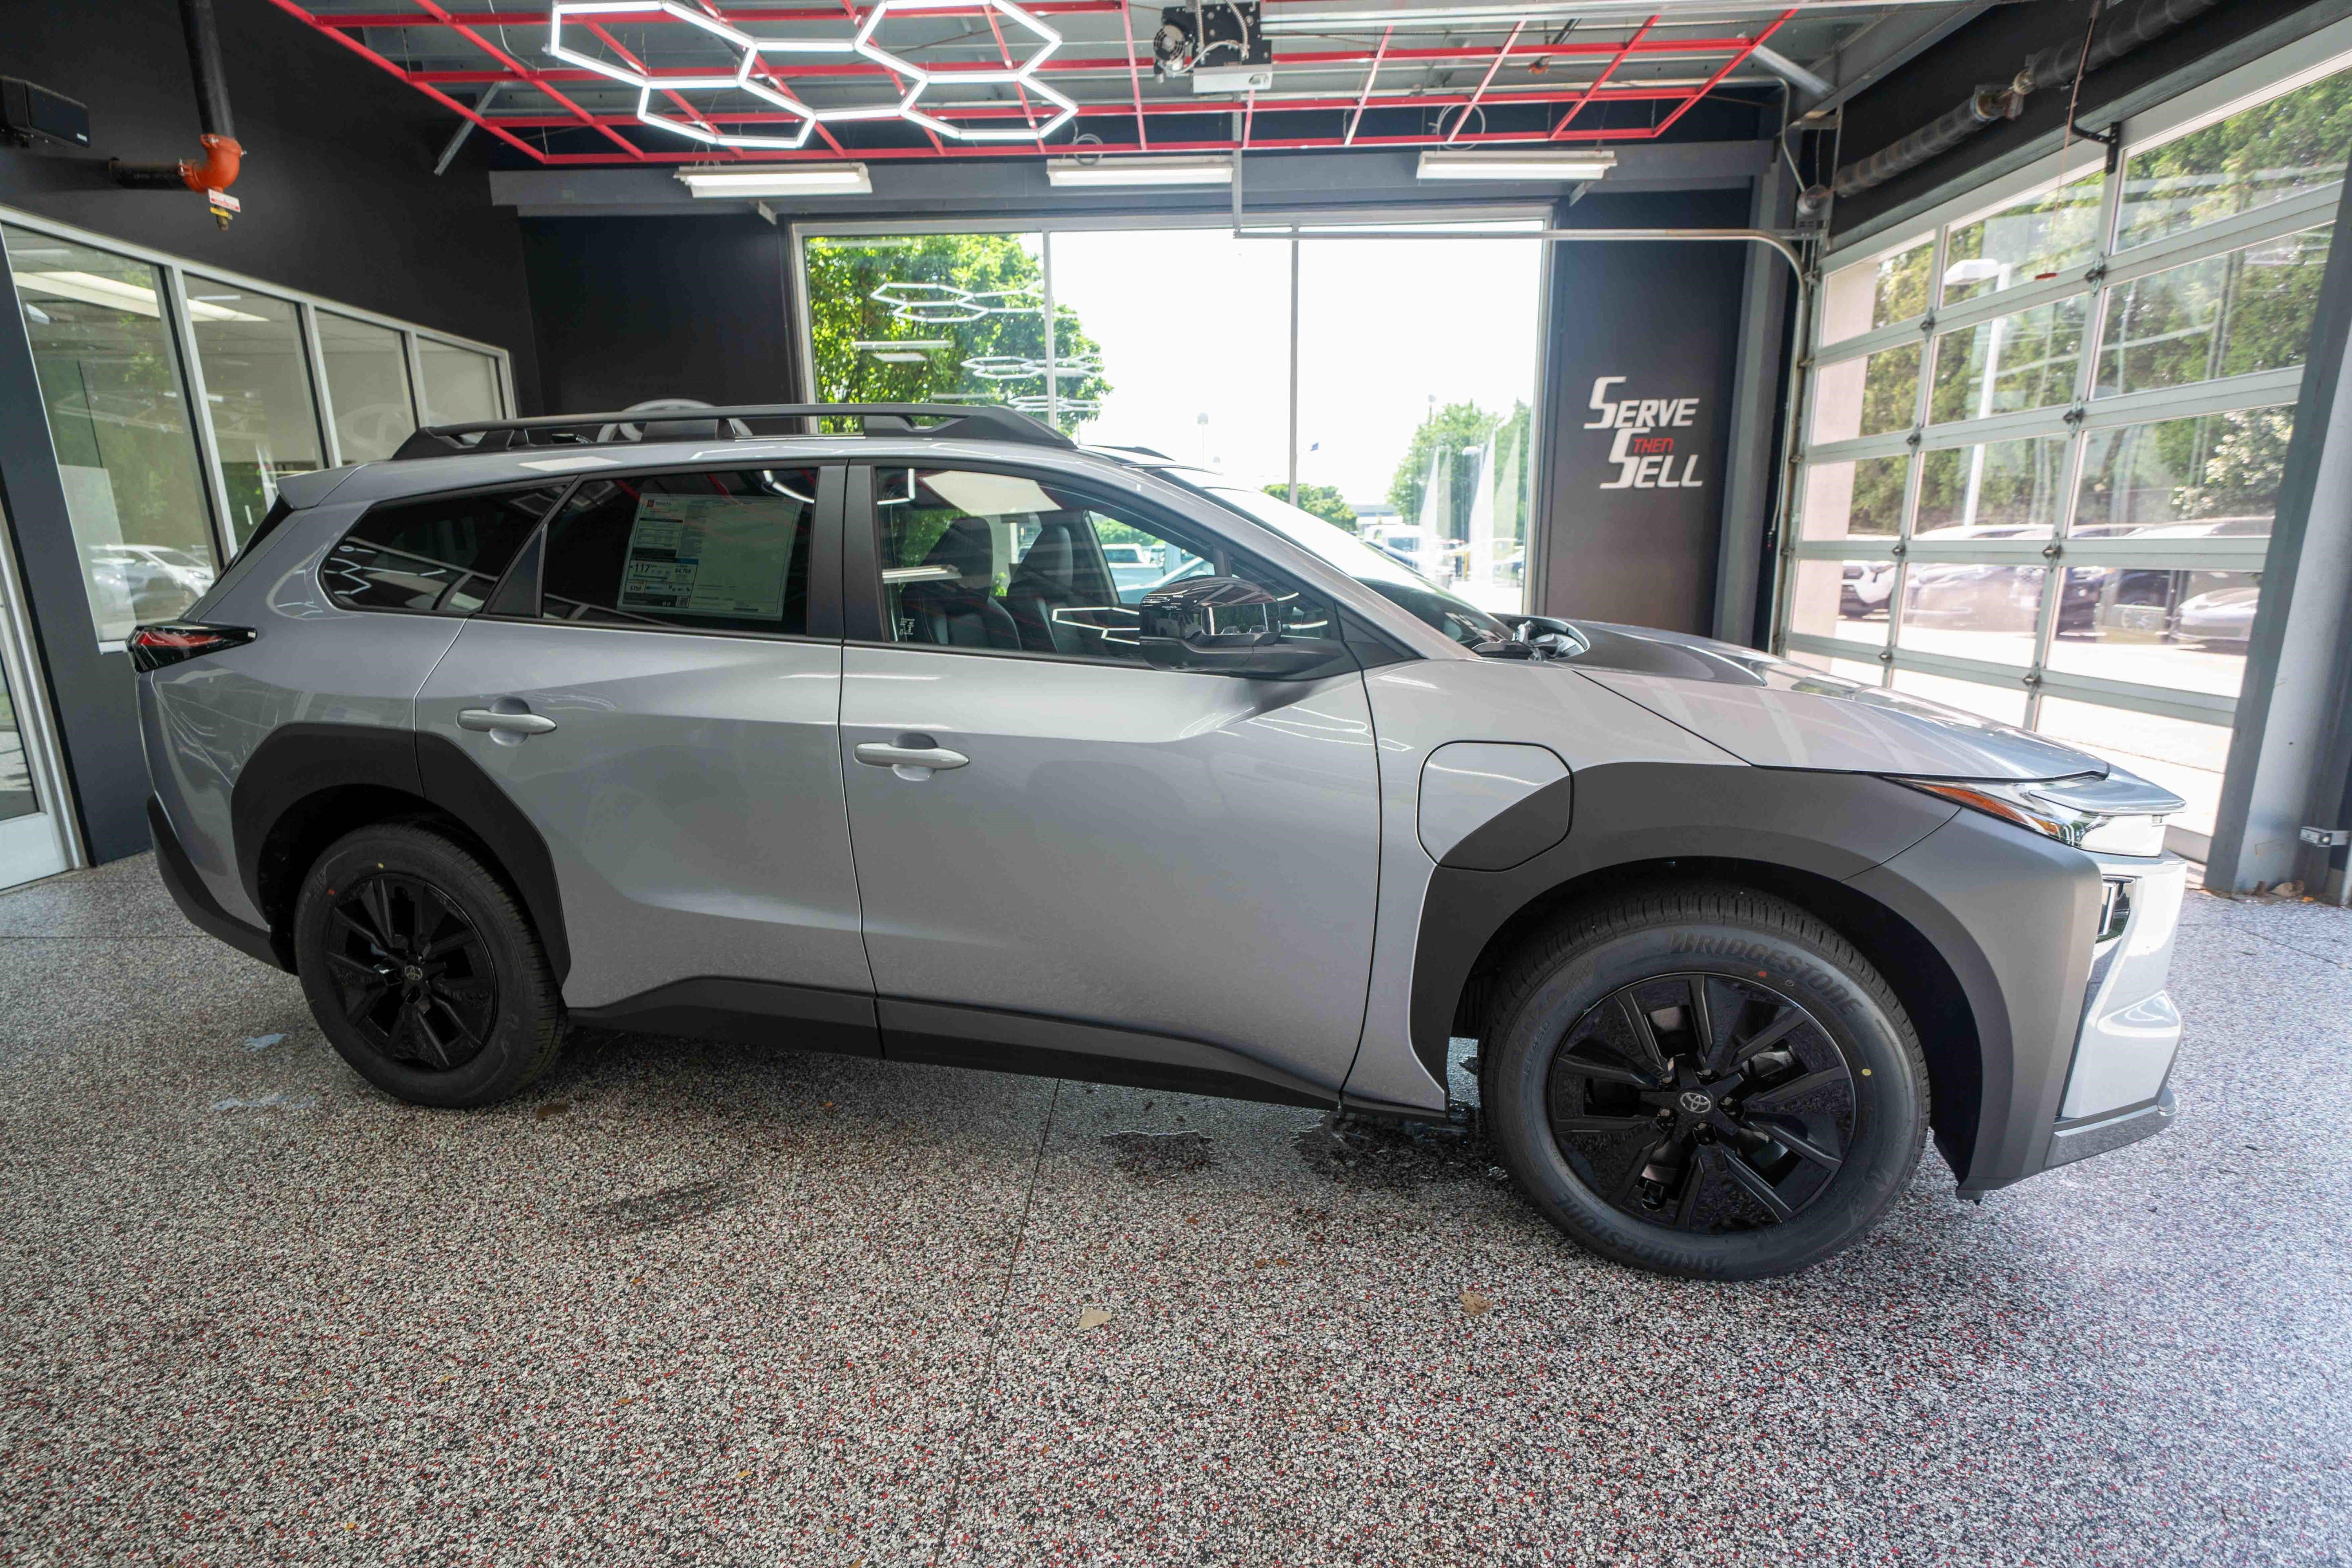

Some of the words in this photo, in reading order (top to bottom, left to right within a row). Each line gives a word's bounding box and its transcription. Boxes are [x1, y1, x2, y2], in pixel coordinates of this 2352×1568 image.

[1584, 376, 1699, 429] SERVE
[1599, 427, 1703, 489] SELL
[1633, 438, 1674, 453] THEN
[635, 564, 650, 572] 117
[1670, 933, 1864, 1015] BRIDGESTONE
